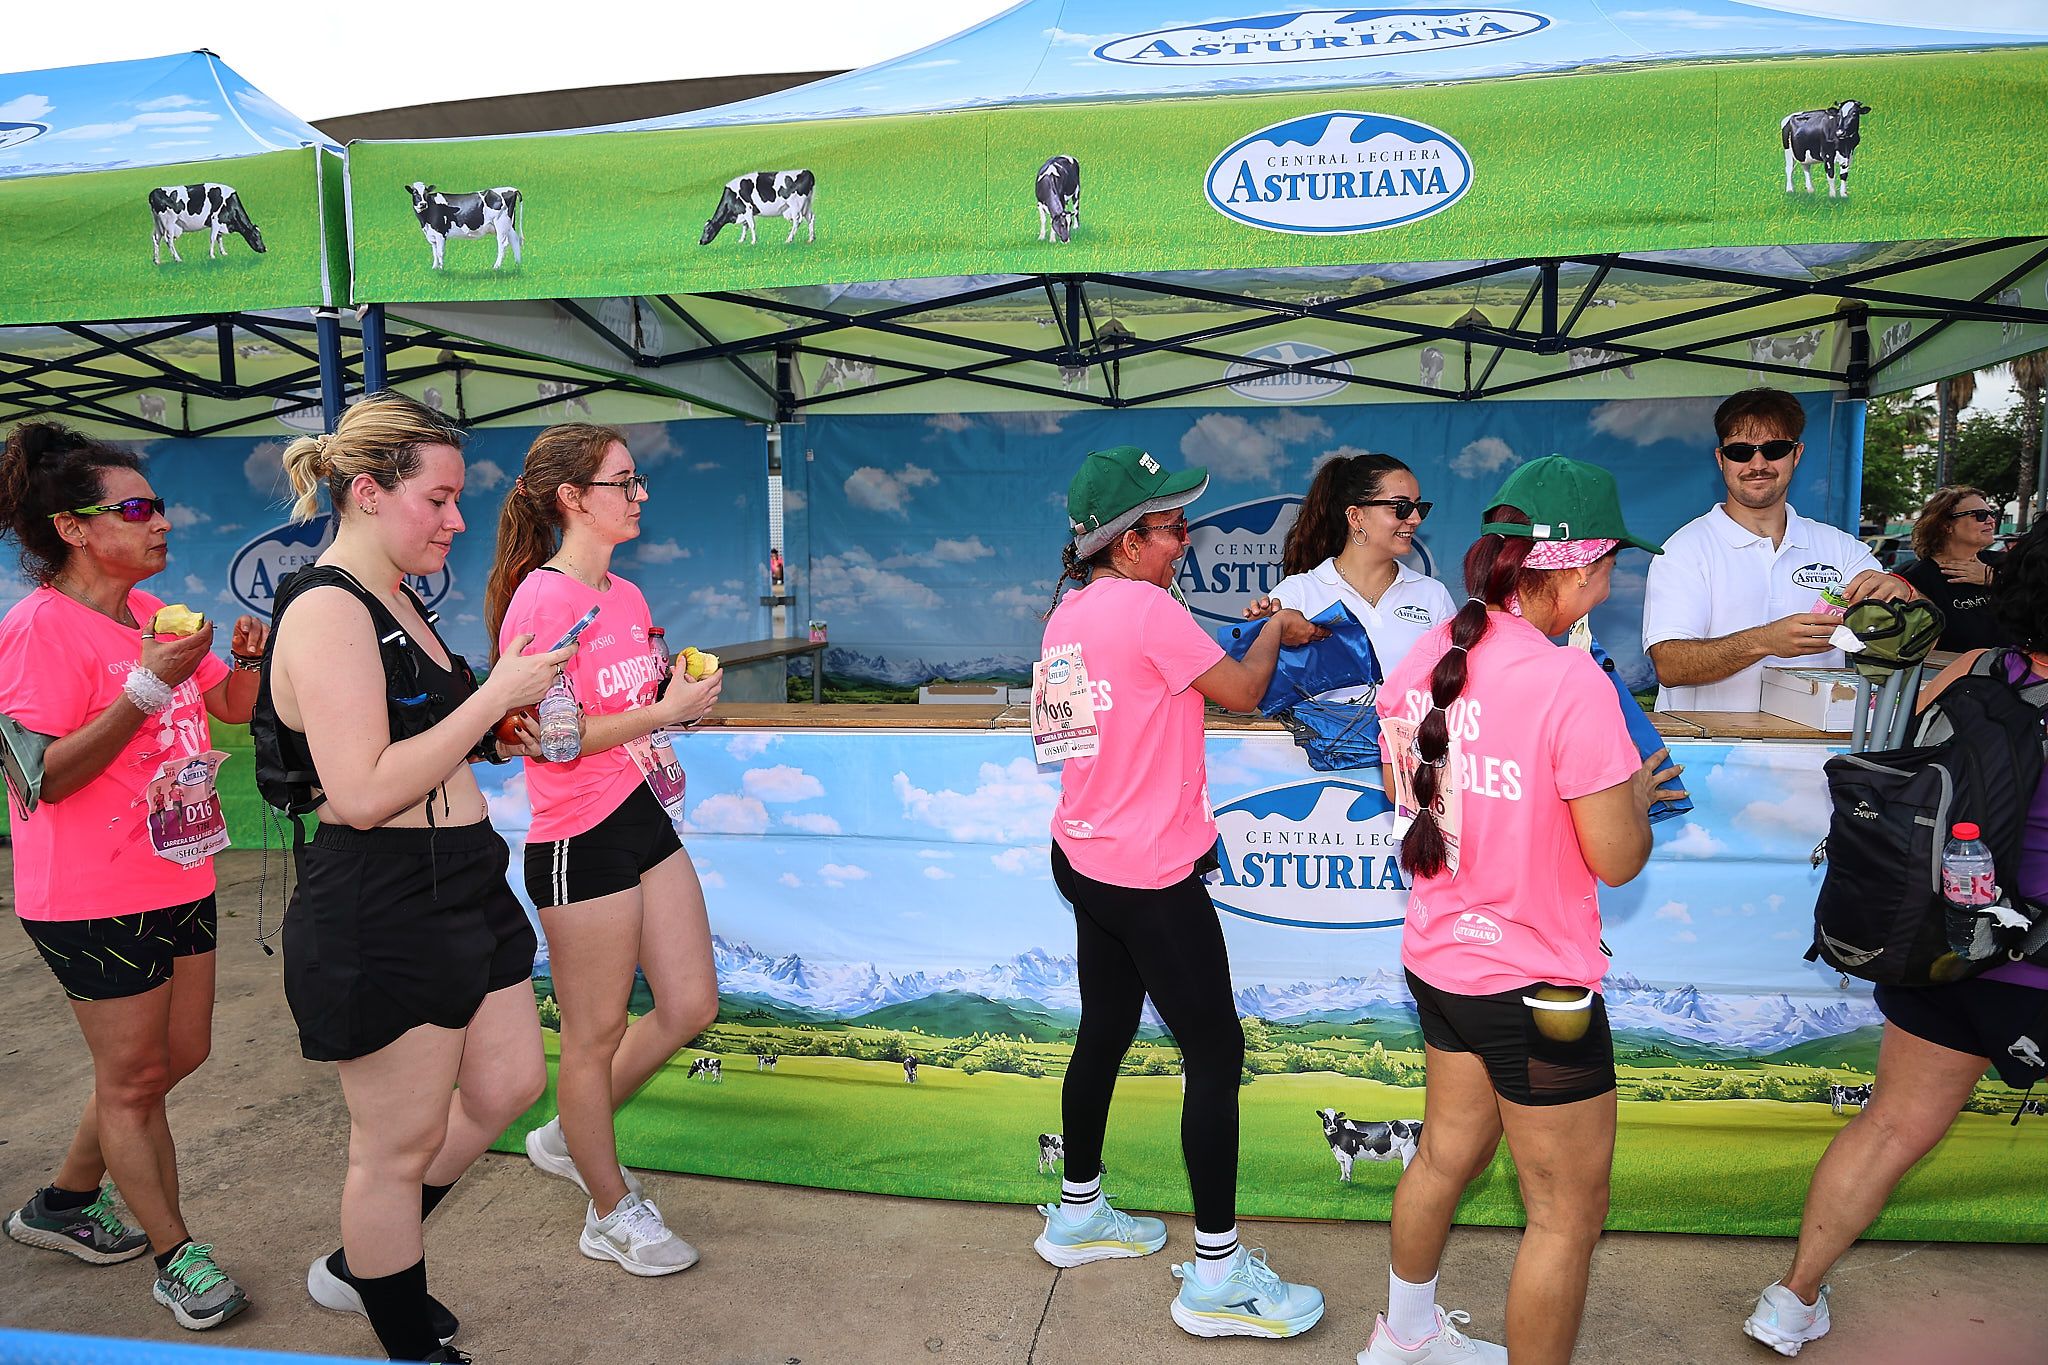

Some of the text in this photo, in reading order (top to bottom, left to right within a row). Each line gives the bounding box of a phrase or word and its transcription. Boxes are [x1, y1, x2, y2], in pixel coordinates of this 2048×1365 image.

[1126, 22, 1518, 59] ASTURIANA
[1197, 15, 1491, 42] CENTRAL LECHERA
[1267, 149, 1441, 167] CENTRAL LECHERA
[1227, 159, 1450, 203] ASTURIANA
[1215, 543, 1284, 555] CENTR
[1178, 546, 1284, 593] ASTU
[1049, 701, 1073, 720] 016
[1406, 689, 1481, 742] SOOS
[1245, 830, 1395, 847] CENTRAL LEC
[1201, 833, 1413, 891] ASTURIA
